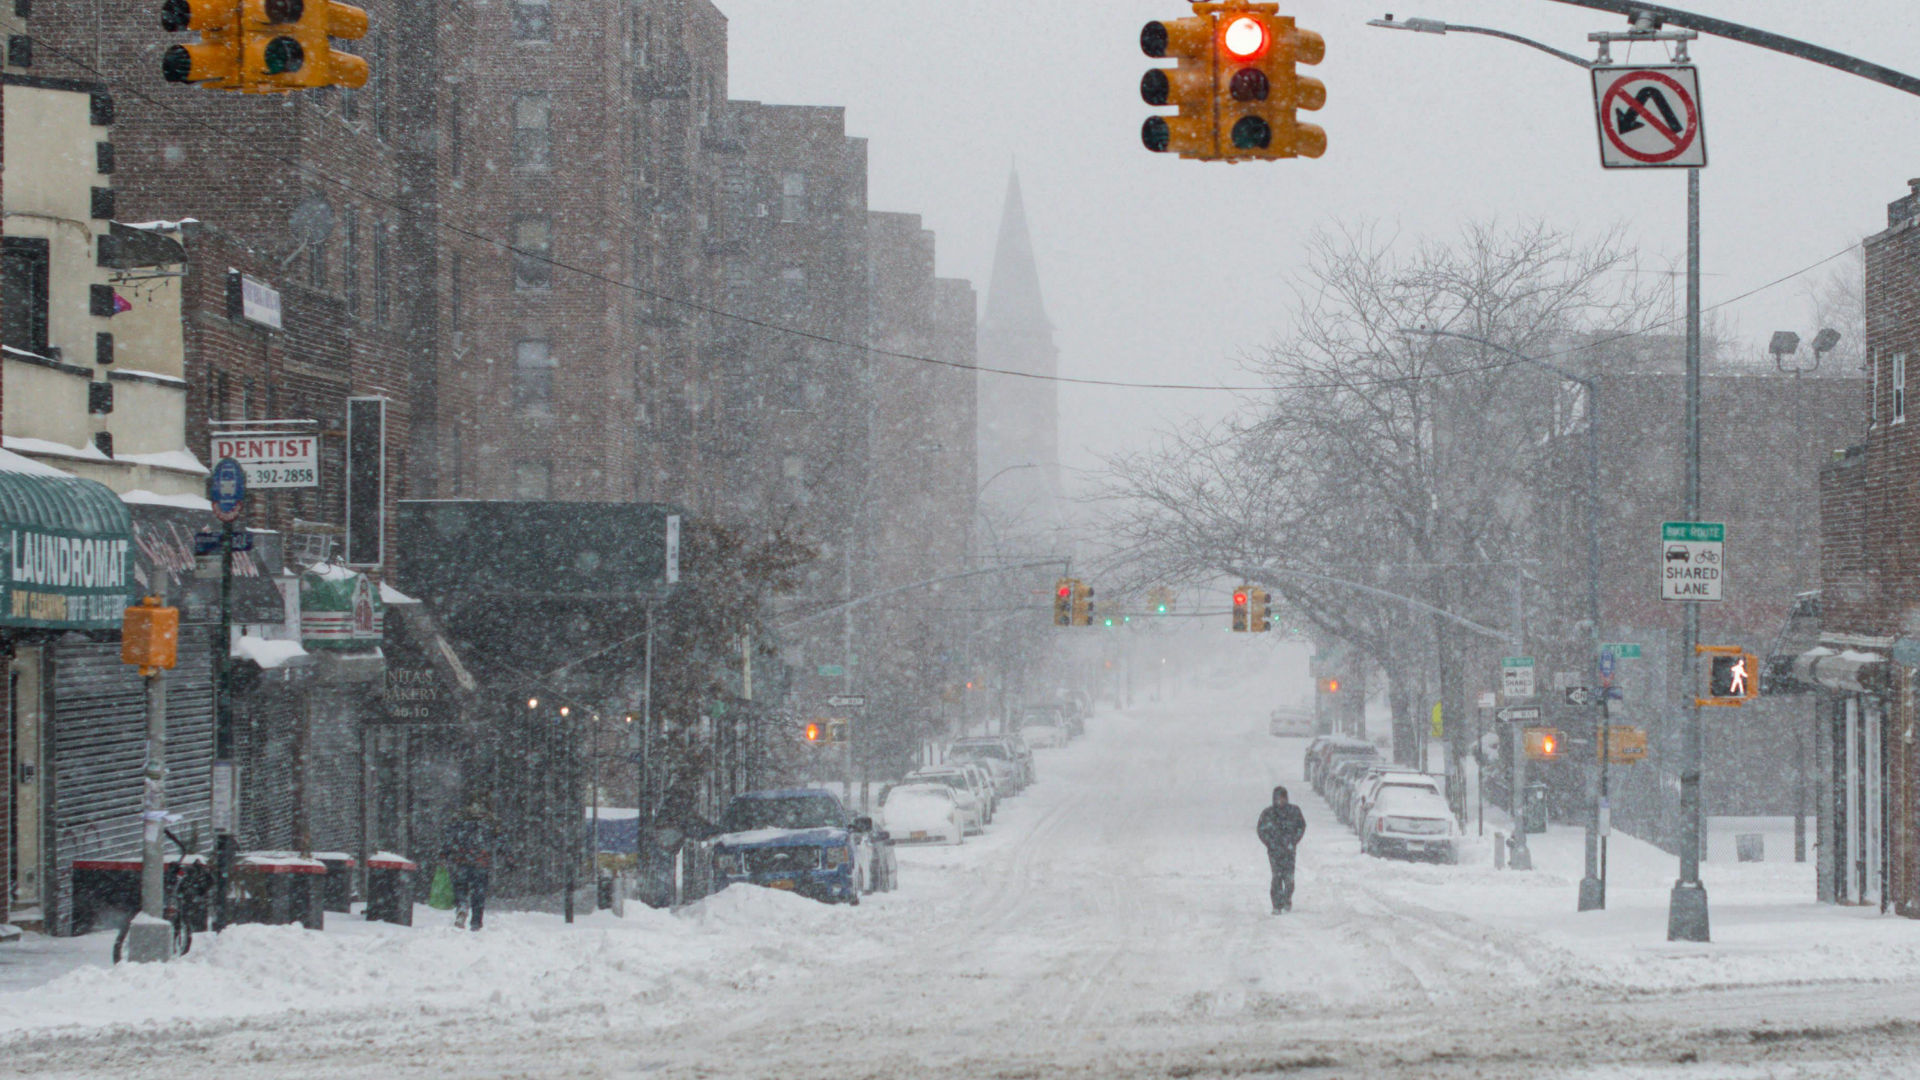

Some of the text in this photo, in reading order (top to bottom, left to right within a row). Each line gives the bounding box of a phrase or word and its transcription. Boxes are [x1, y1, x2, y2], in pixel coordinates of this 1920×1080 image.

[218, 440, 311, 458] DENTIST
[257, 469, 313, 483] 392-2858
[1666, 526, 1720, 538] BIKE ROUTE
[12, 530, 128, 588] LAUNDROMAT
[1666, 567, 1719, 579] SHARED
[1674, 583, 1709, 595] LANE
[1505, 679, 1532, 687] SHARED
[382, 687, 438, 700] BAKERY
[393, 707, 429, 717] 40-10
